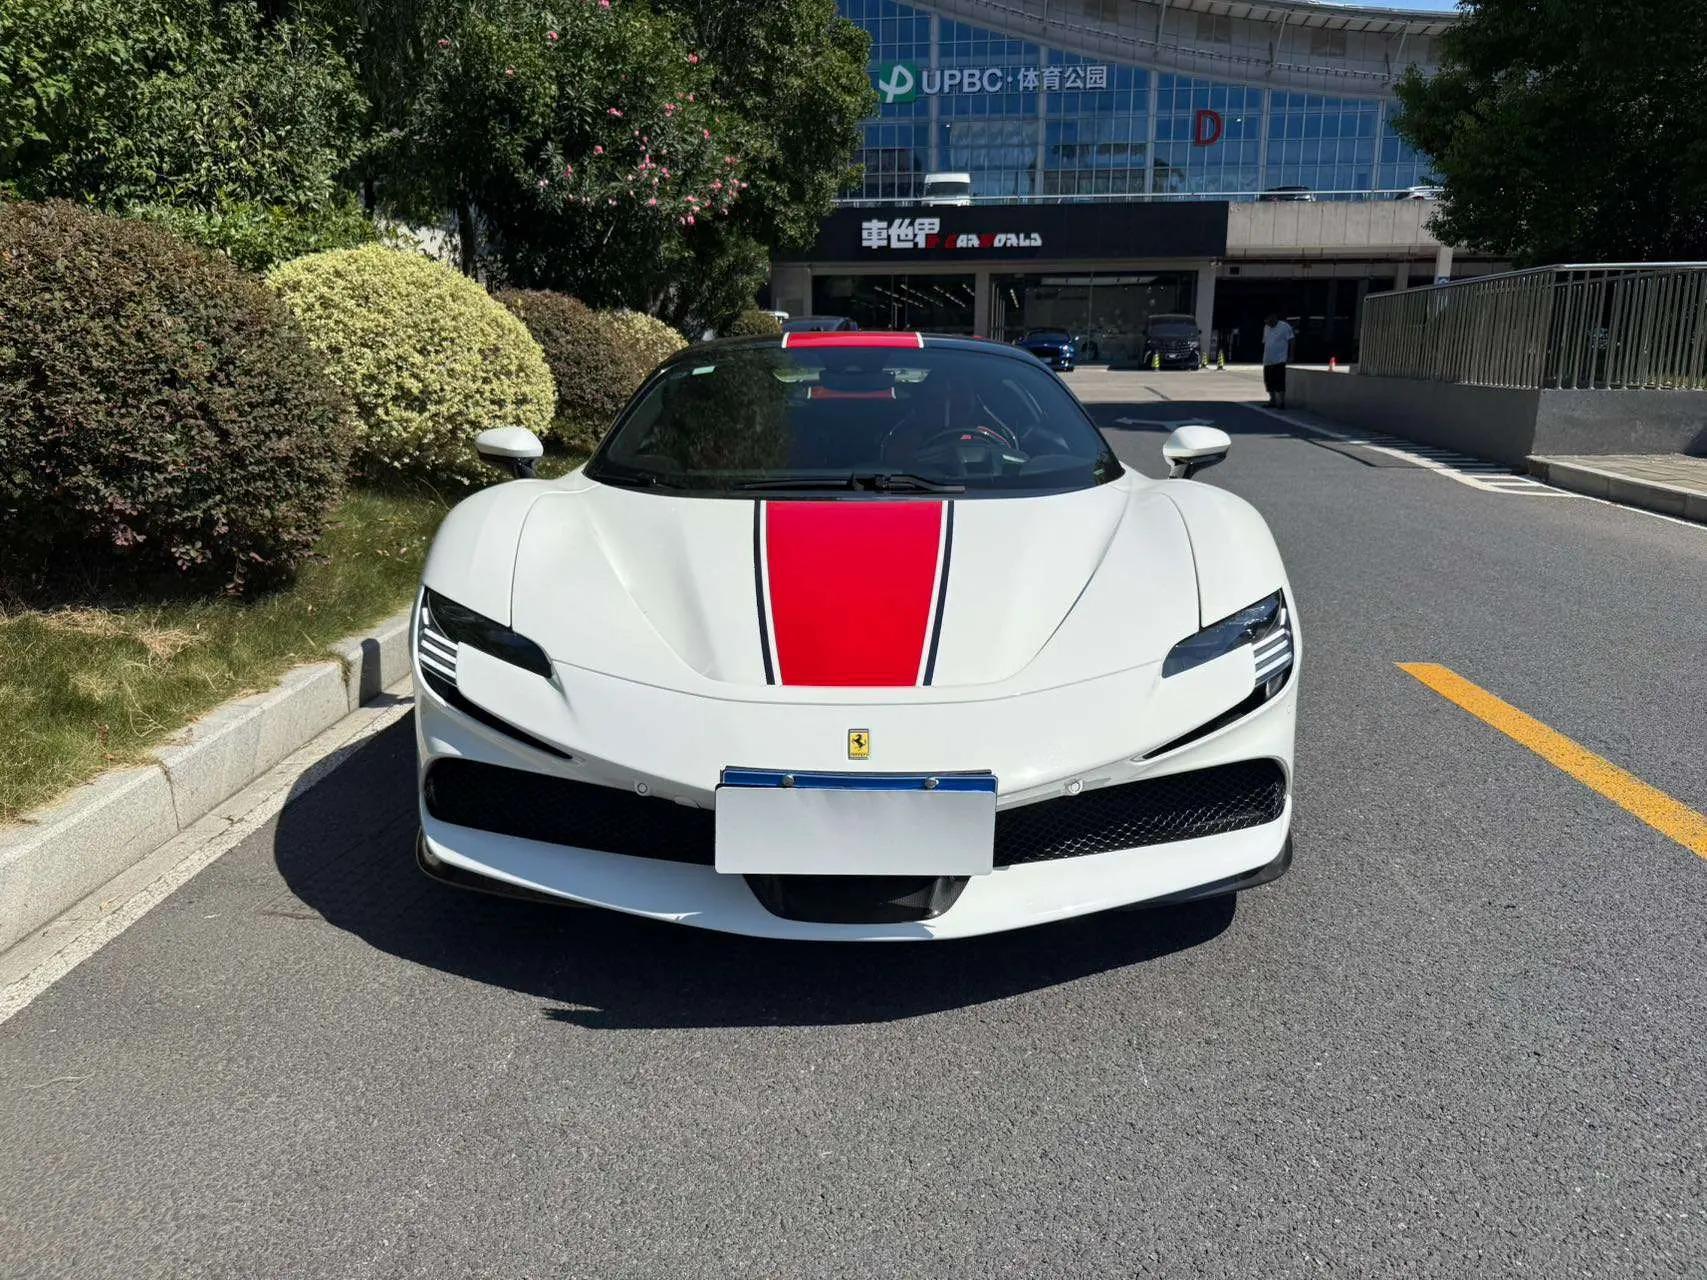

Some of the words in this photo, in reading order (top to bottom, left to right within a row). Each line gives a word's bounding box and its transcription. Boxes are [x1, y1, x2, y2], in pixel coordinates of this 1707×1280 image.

[1194, 109, 1223, 147] D
[862, 217, 940, 249] 車世界
